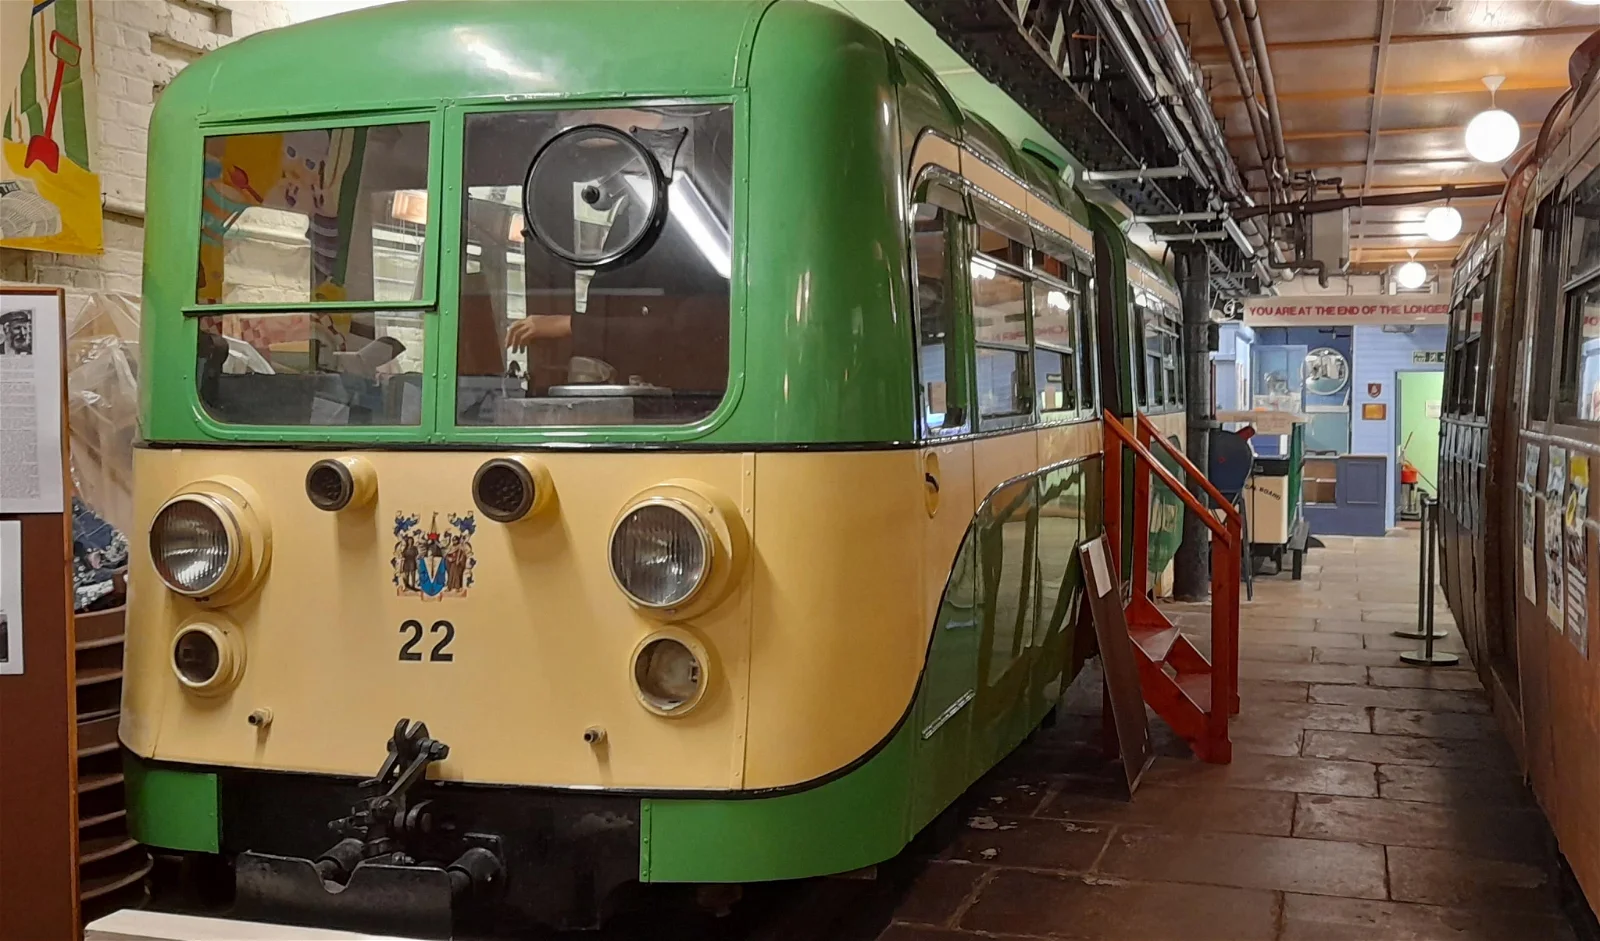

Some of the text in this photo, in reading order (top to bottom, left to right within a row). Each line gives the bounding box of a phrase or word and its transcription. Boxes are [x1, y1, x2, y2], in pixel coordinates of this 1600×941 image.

[1249, 305, 1273, 316] YOU
[1275, 305, 1297, 316] ARE
[1298, 305, 1312, 316] AT
[1315, 305, 1336, 316] THE
[1337, 305, 1360, 316] END
[1361, 305, 1377, 315] OF
[1379, 304, 1402, 315] THE
[398, 619, 455, 662] 22
